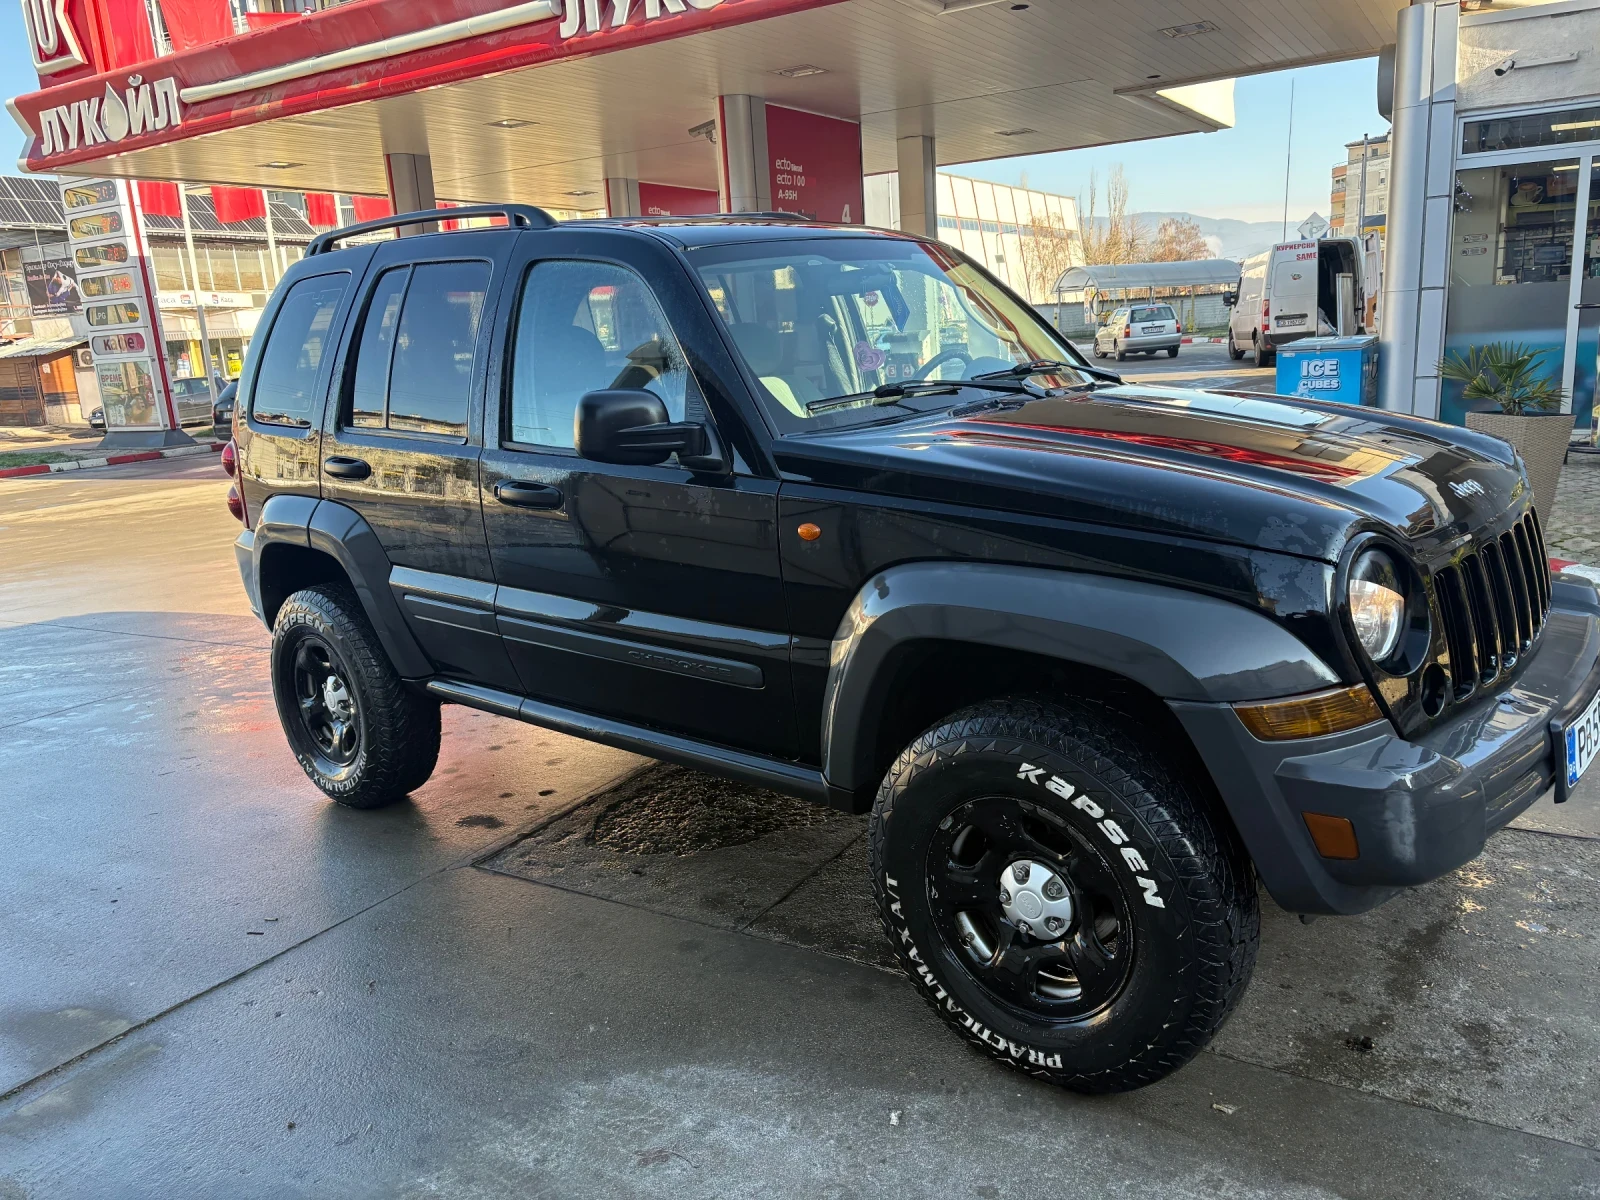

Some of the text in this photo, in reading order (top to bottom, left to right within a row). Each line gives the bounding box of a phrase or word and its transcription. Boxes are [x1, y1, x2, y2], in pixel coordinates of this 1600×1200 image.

[776, 158, 791, 171] ecto
[777, 172, 806, 187] ecto 100
[778, 189, 798, 200] A-95H
[842, 204, 852, 224] 4
[1296, 252, 1317, 261] SAME
[1301, 360, 1339, 377] ICE
[1300, 379, 1340, 391] CUBES
